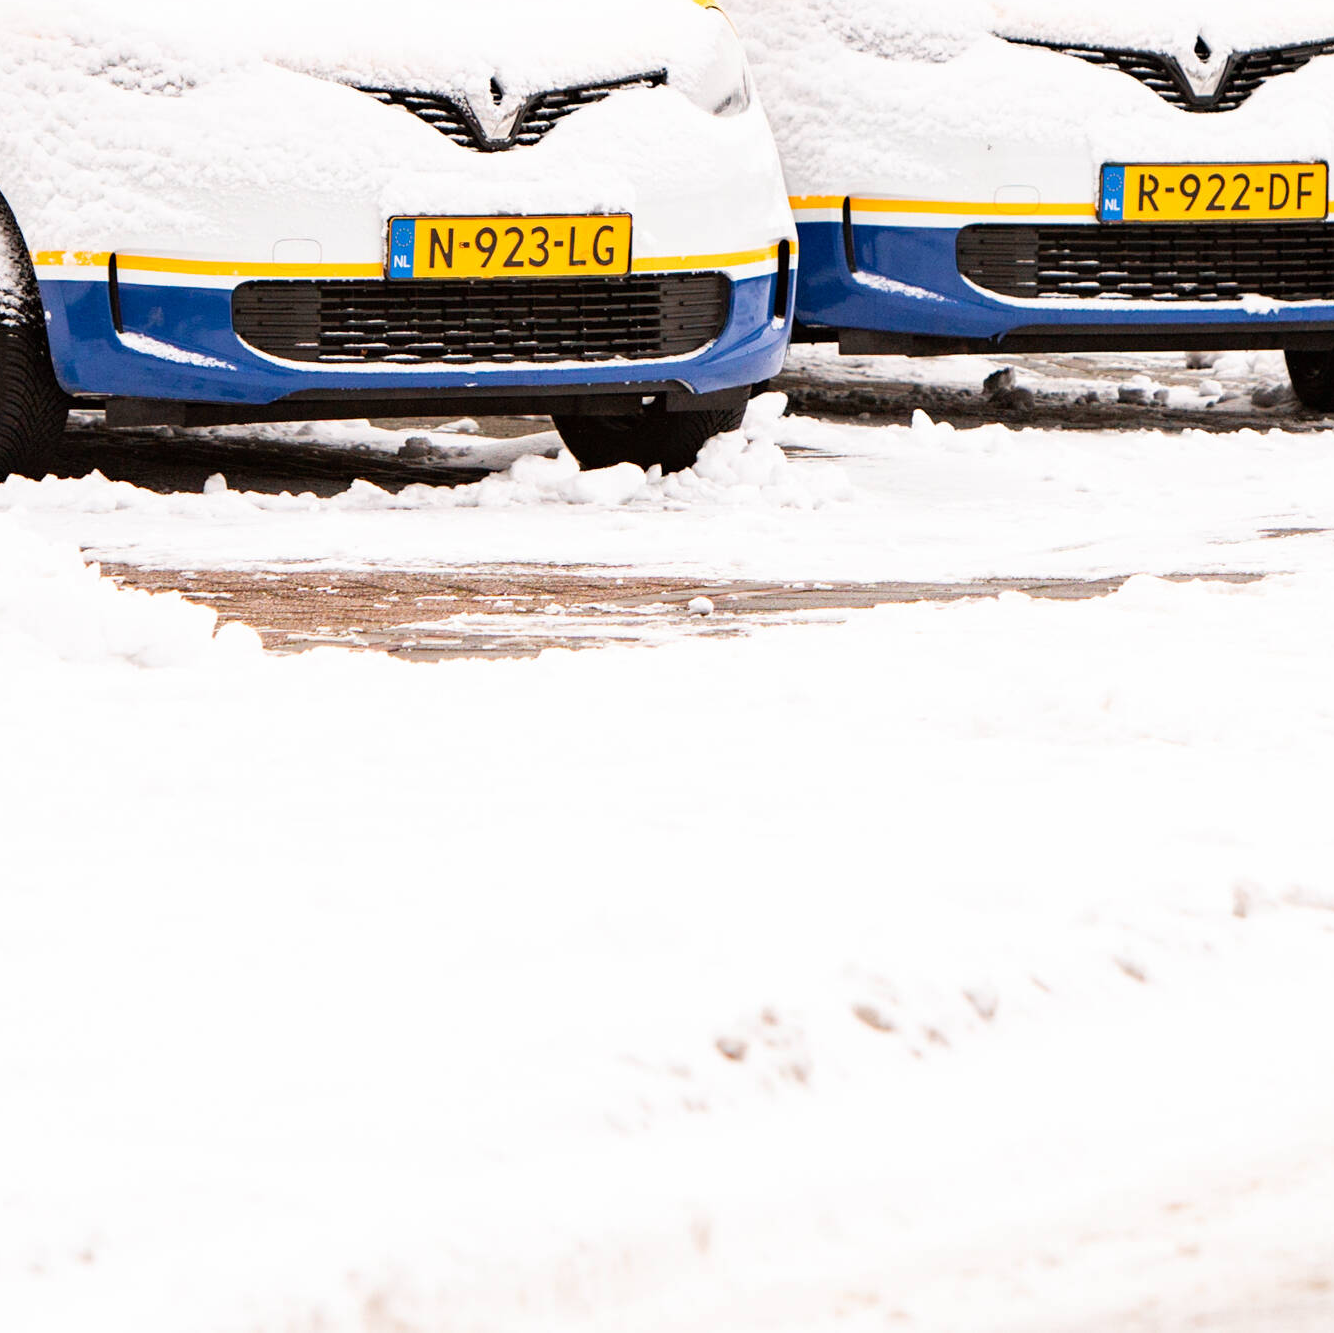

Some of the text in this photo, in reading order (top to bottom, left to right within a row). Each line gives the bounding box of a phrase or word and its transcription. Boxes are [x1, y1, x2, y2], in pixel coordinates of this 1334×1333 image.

[1104, 171, 1315, 212] NL R-922-DF
[393, 224, 615, 269] NL N-923-LG
